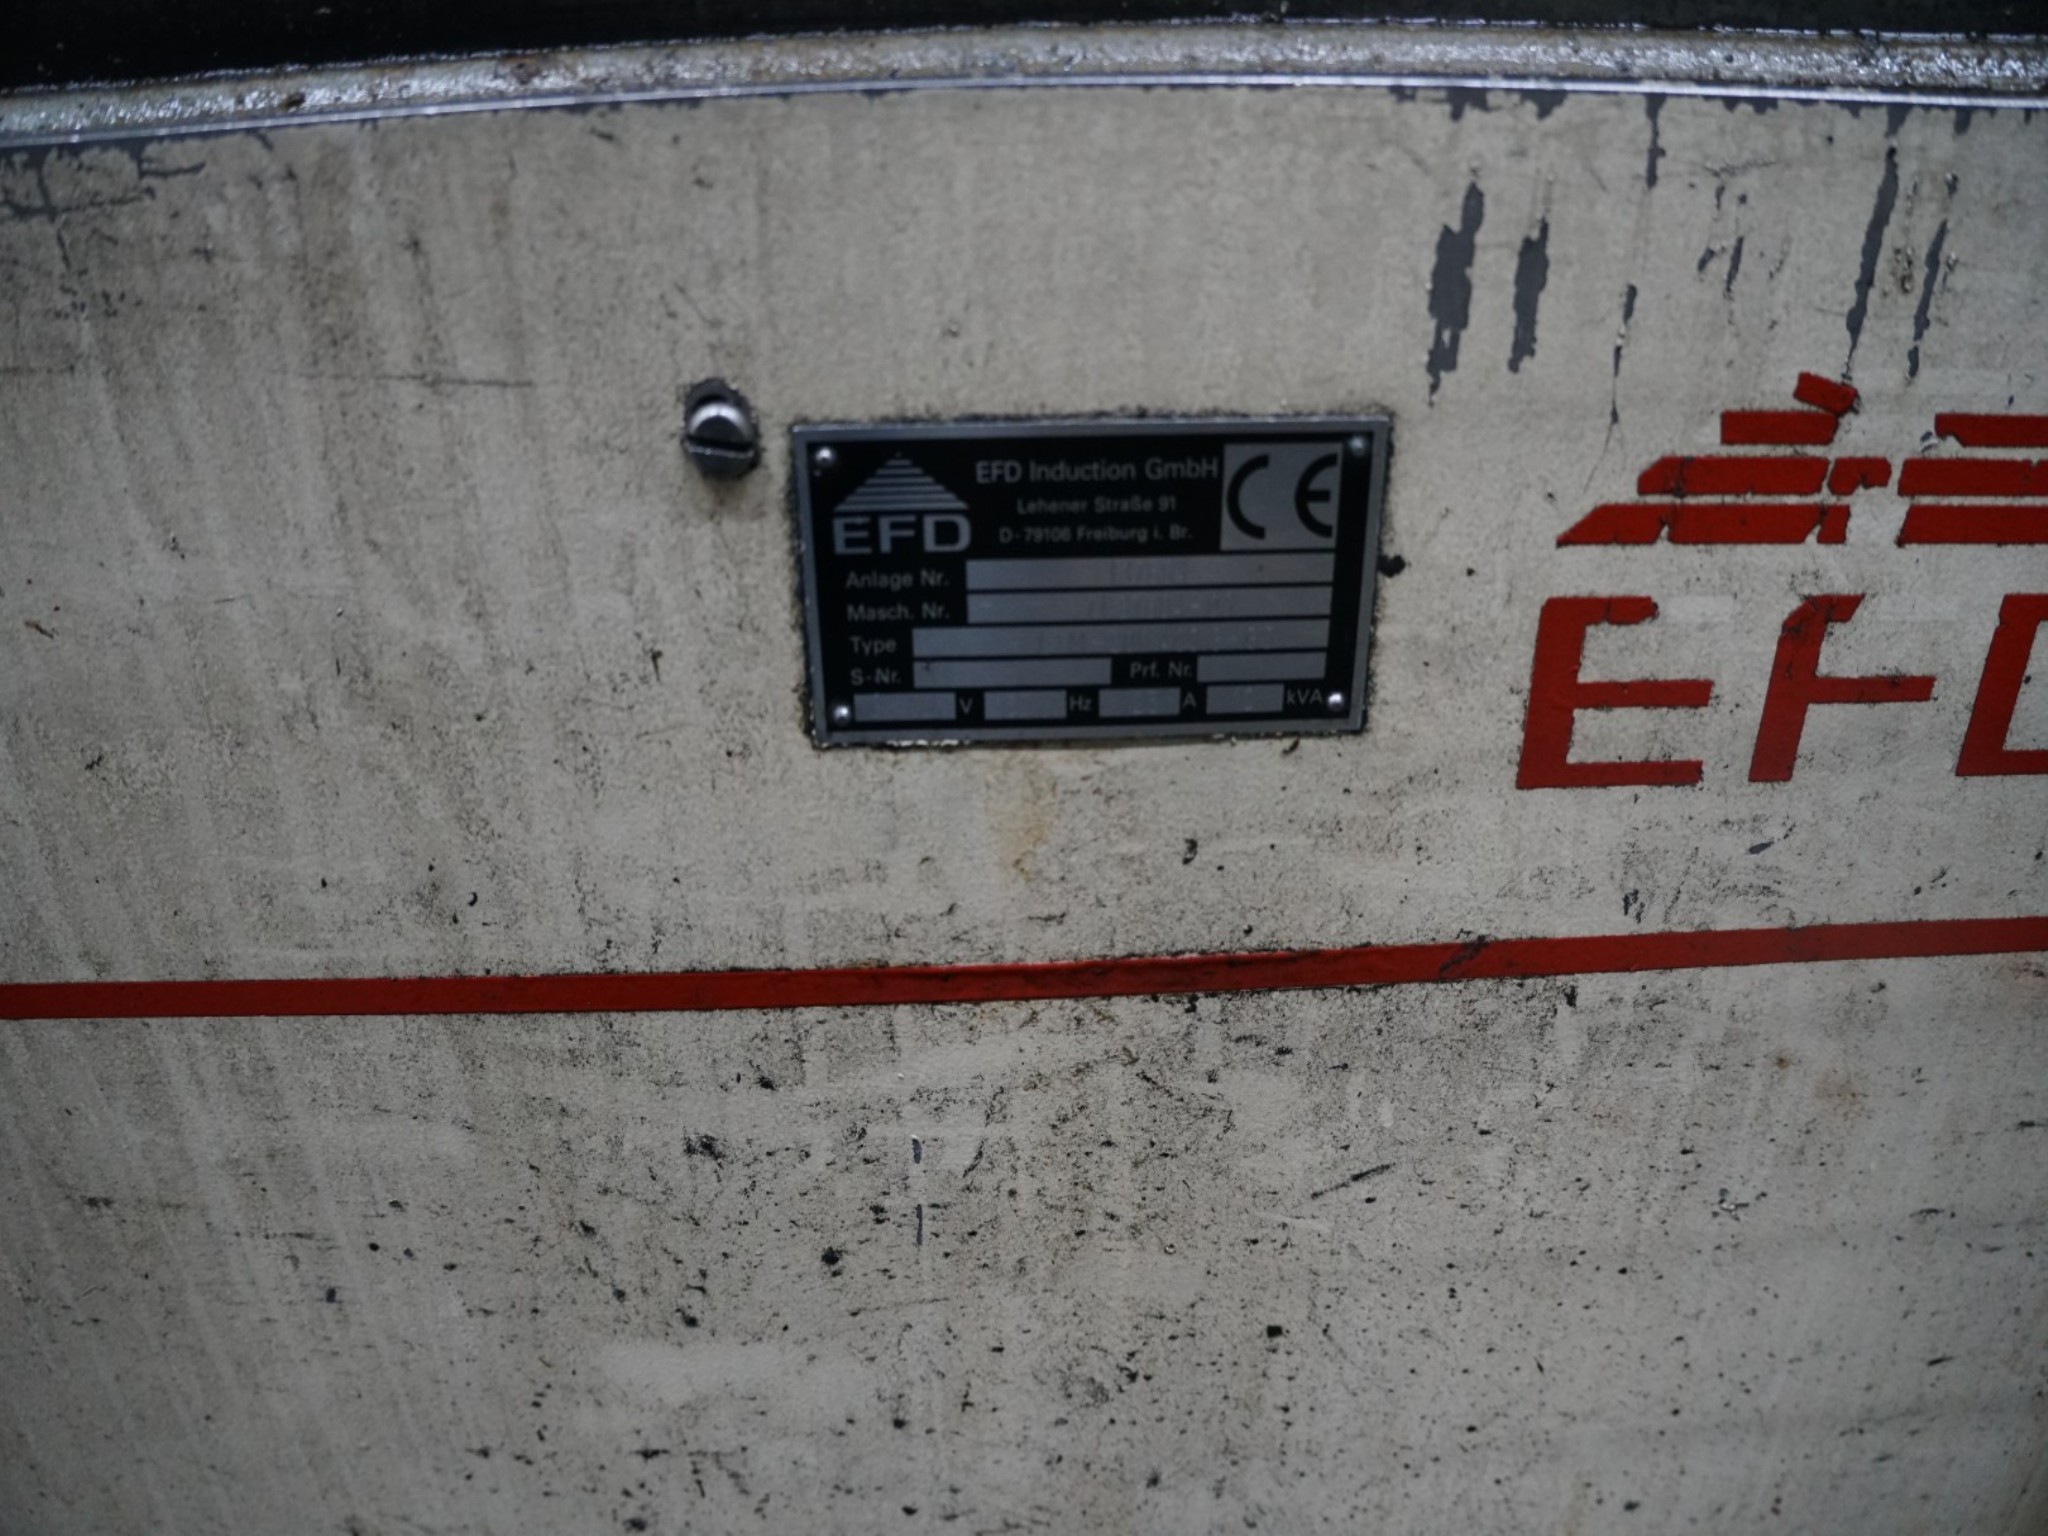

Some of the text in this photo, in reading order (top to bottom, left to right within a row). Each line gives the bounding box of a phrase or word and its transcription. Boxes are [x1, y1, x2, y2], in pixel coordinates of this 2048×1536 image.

[975, 456, 1219, 484] EFD Induction GmbH
[1017, 495, 1176, 515] Lehener Straße 91
[832, 512, 972, 555] EFD
[1077, 525, 1148, 544] Freiburg
[1169, 523, 1194, 540] Br.
[846, 568, 950, 592] Anlage Nr.
[846, 601, 950, 621] Masch. Nr.
[849, 635, 897, 657] Type
[850, 667, 902, 686] S-Nr.
[1129, 661, 1193, 679] Prf. Nr.
[959, 688, 1324, 714] V Hz A kVA
